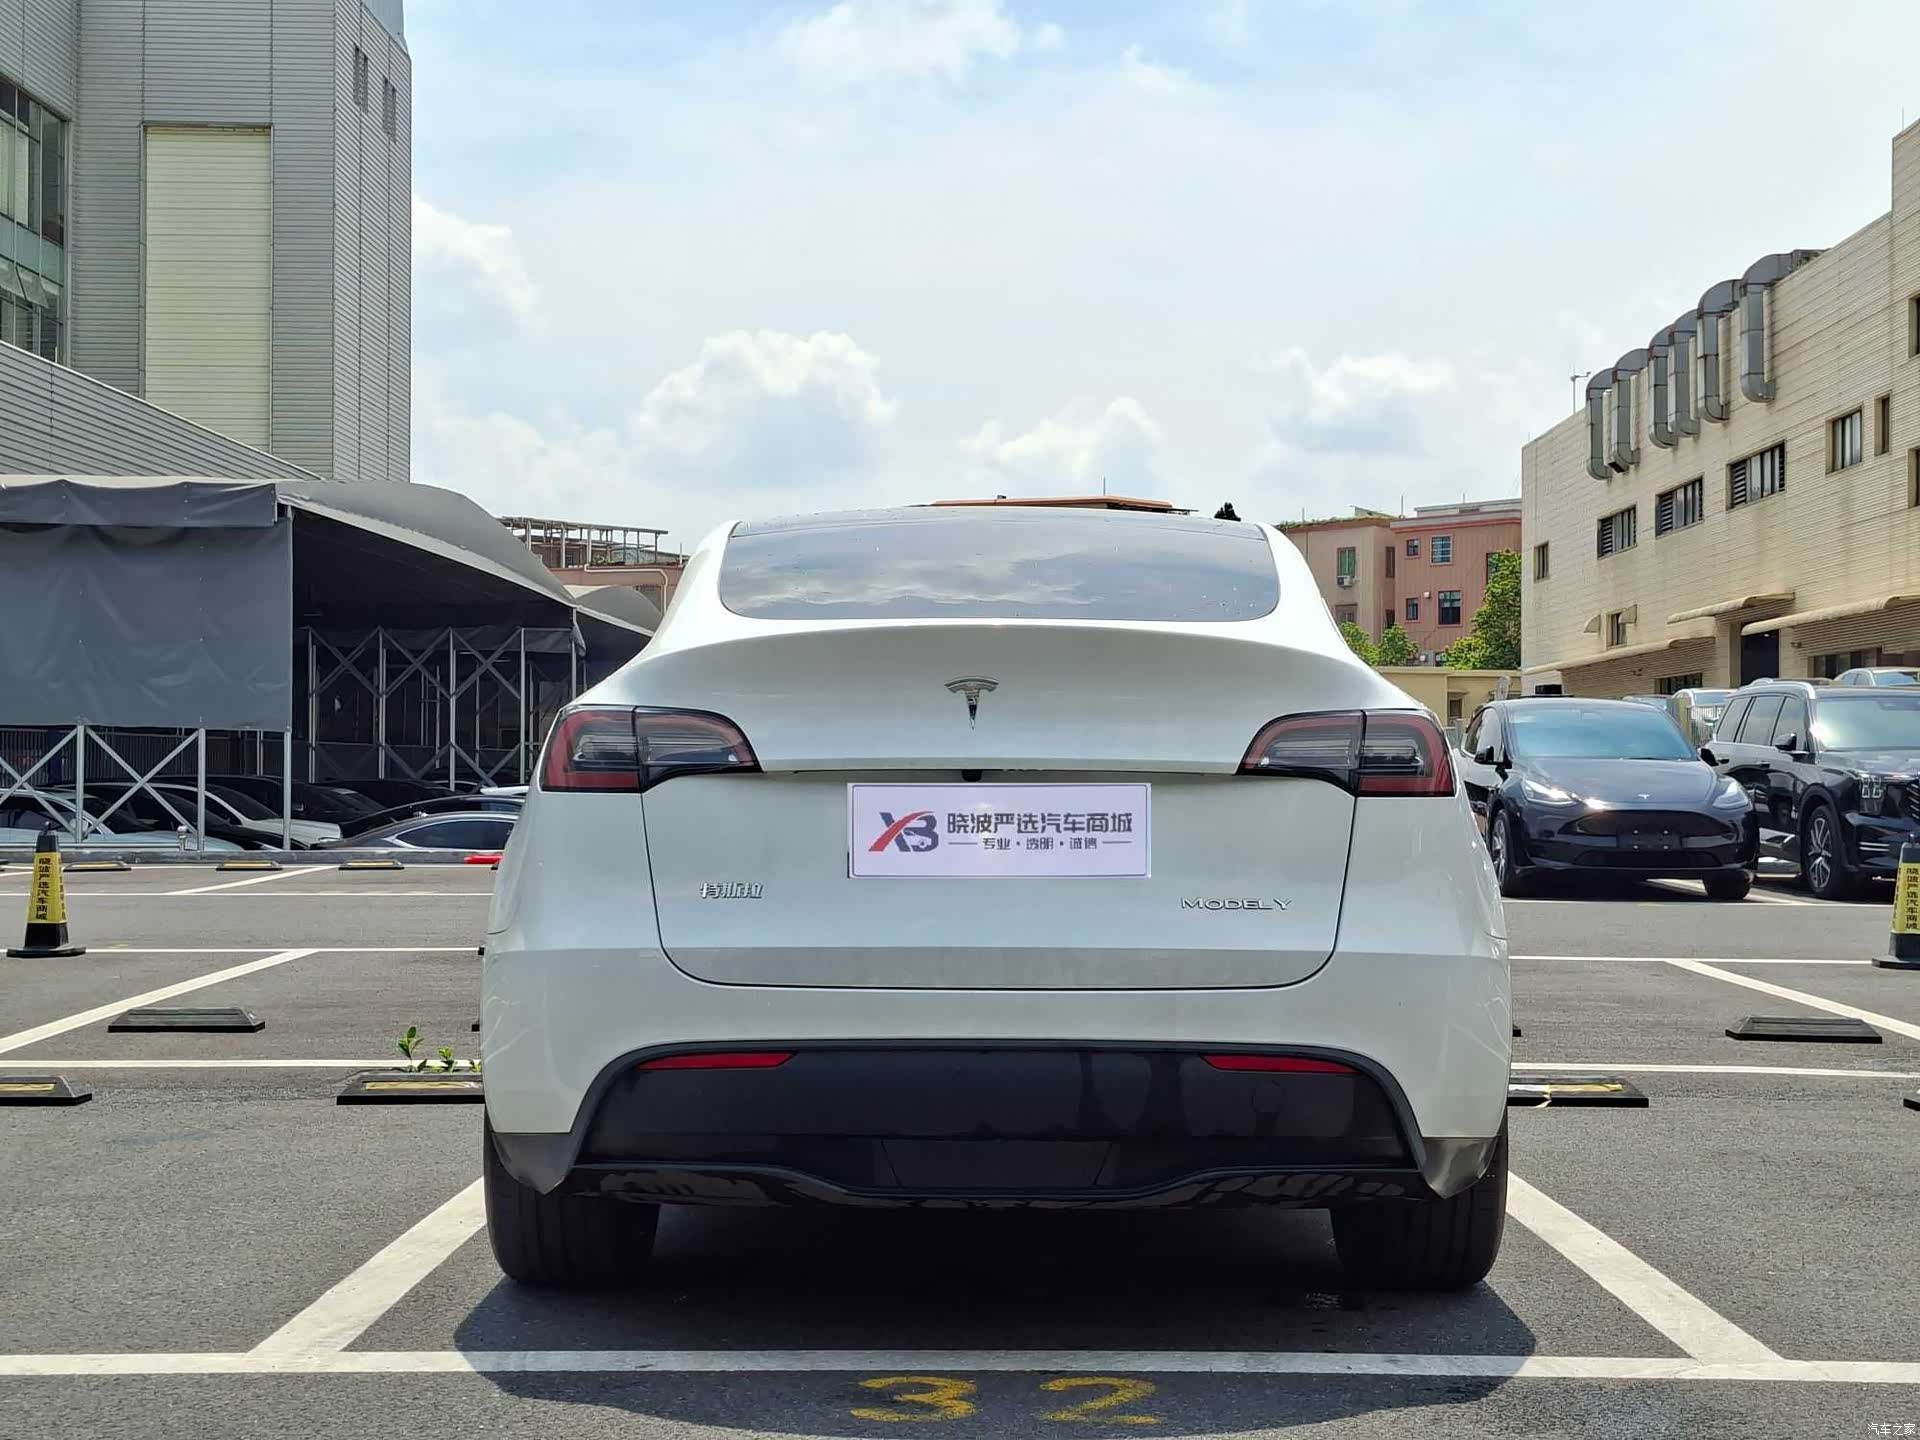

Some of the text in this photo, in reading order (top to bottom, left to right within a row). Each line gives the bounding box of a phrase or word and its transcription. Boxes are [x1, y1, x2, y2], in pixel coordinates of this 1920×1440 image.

[946, 812, 1133, 834] 晓波严选汽车商城
[699, 881, 764, 899] 特斯拉
